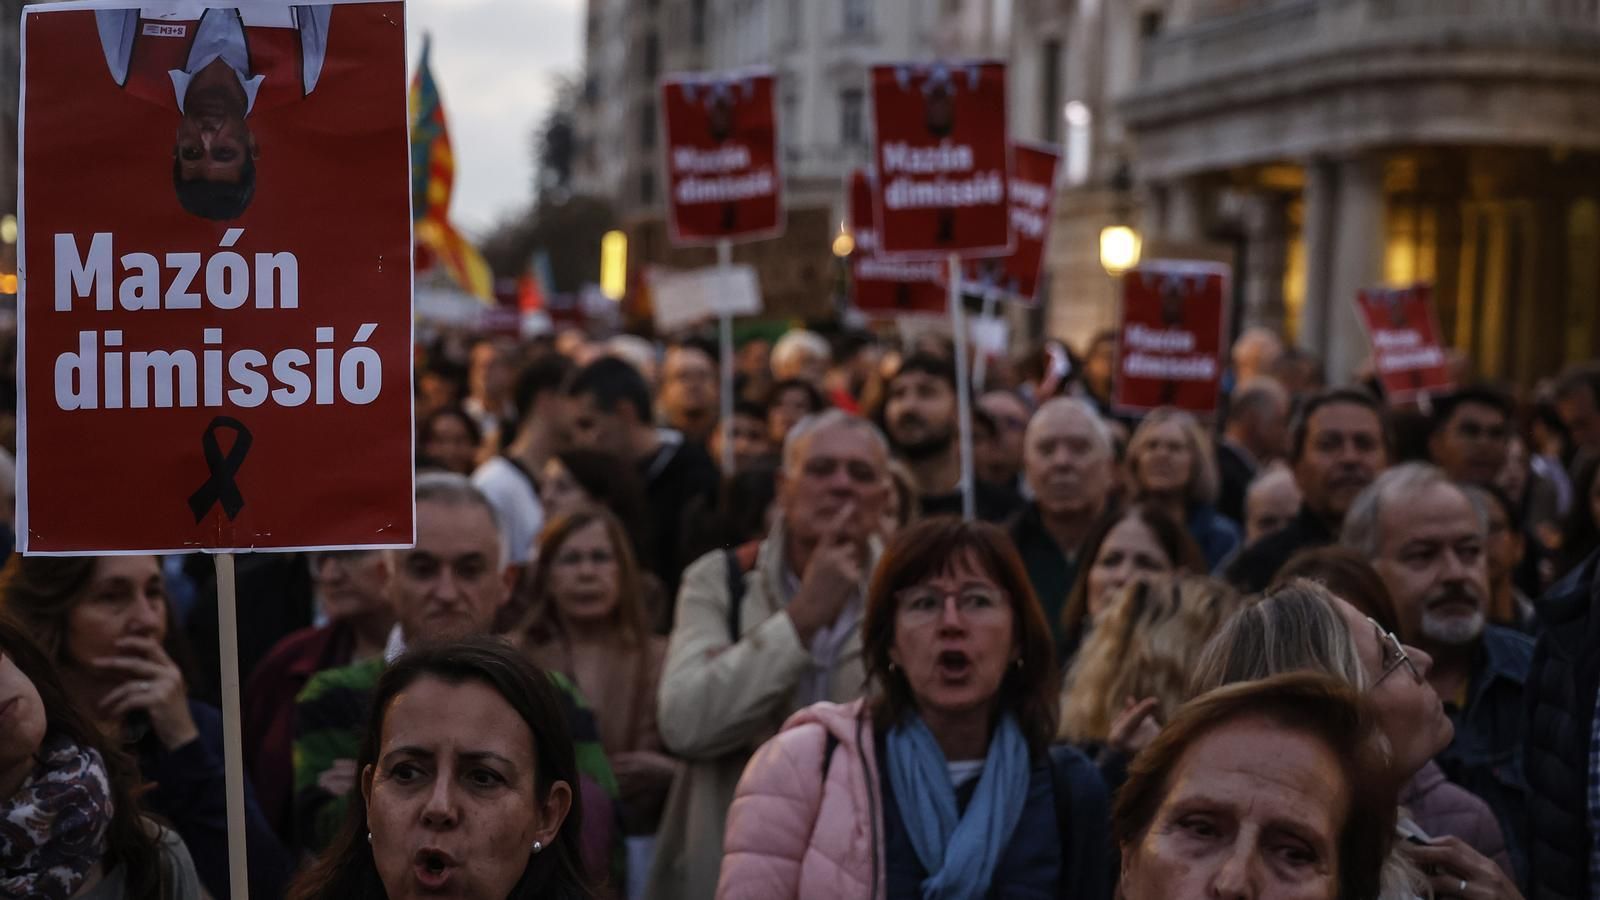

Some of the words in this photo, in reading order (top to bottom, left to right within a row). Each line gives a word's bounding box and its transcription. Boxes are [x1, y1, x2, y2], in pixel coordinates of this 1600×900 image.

[882, 142, 973, 173] Mazón
[885, 171, 1004, 209] dimissió
[54, 228, 299, 311] Mazón
[54, 323, 382, 410] dimissió
